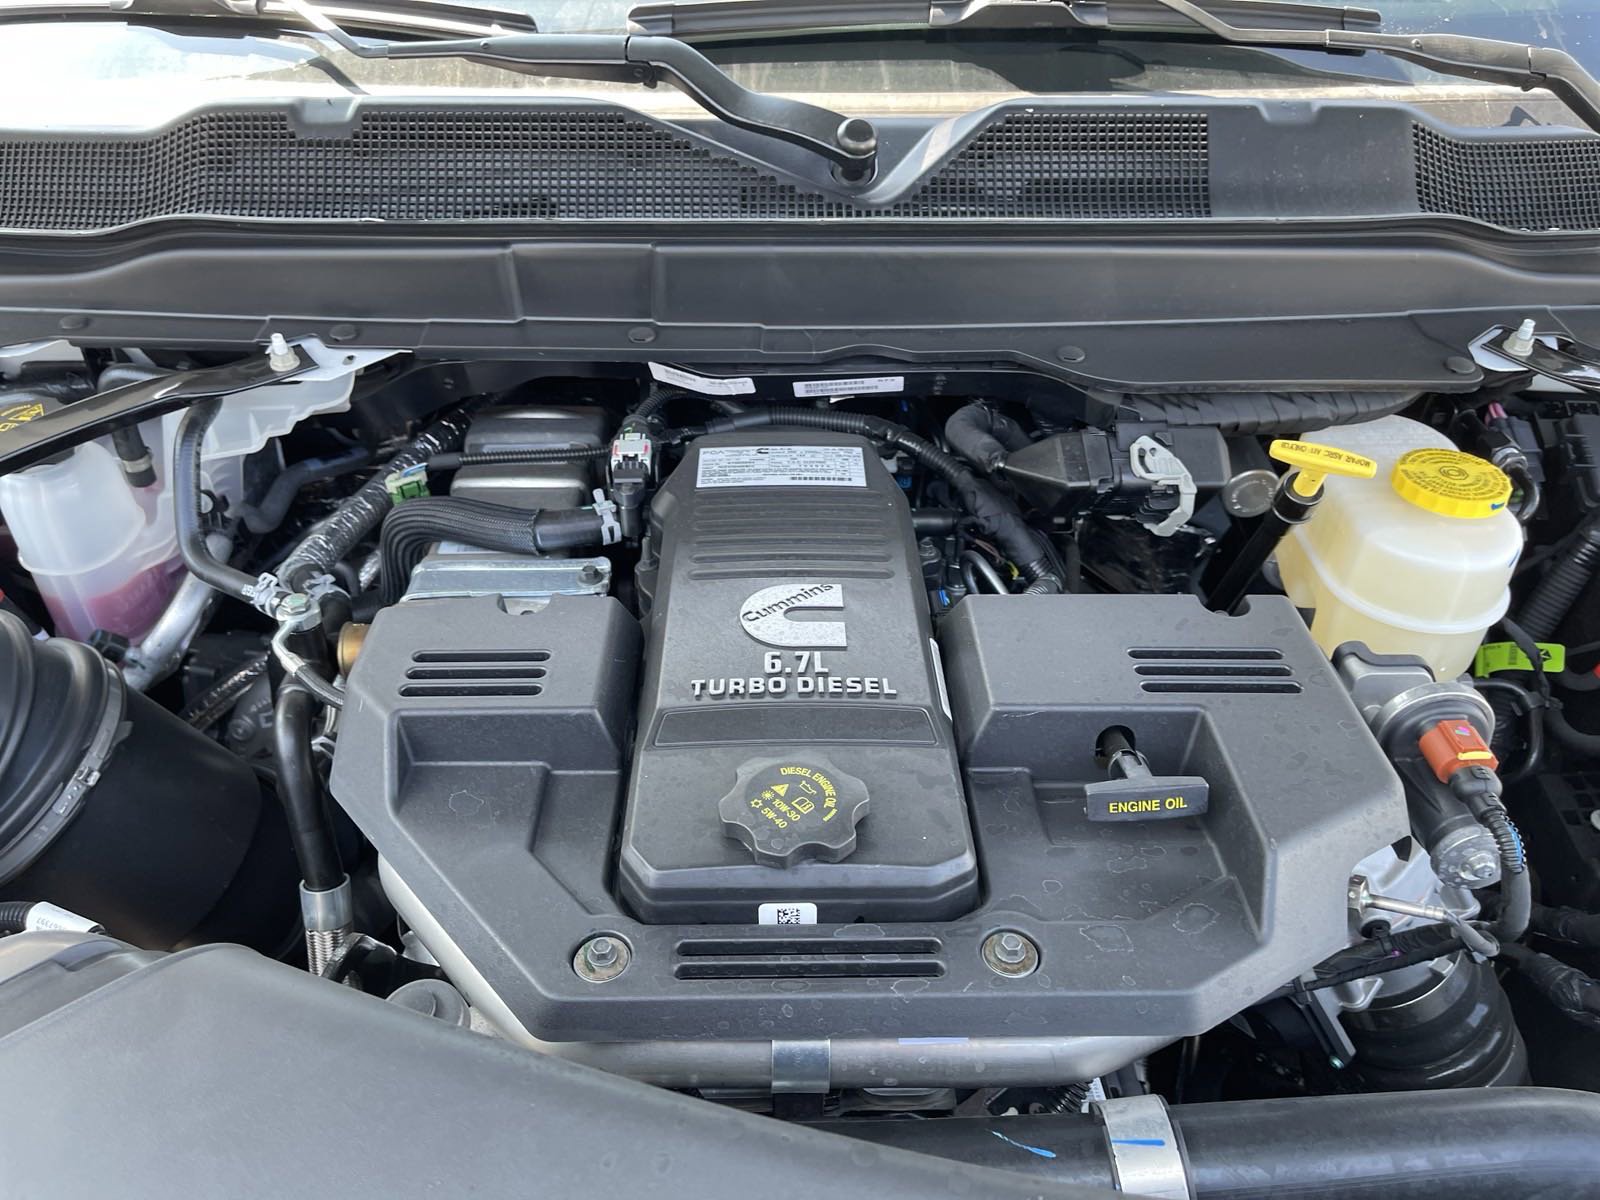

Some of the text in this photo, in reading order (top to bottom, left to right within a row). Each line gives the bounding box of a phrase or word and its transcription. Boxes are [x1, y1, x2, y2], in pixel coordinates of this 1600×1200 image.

[741, 583, 834, 623] Cummins
[764, 651, 829, 675] 6.7L
[691, 676, 897, 698] TURBO DIESEL
[780, 767, 837, 808] DIESEL ENGINE OIL
[772, 799, 801, 821] 10W-30
[1108, 796, 1188, 814] ENGINE OIL
[761, 807, 788, 829] 5W-40
